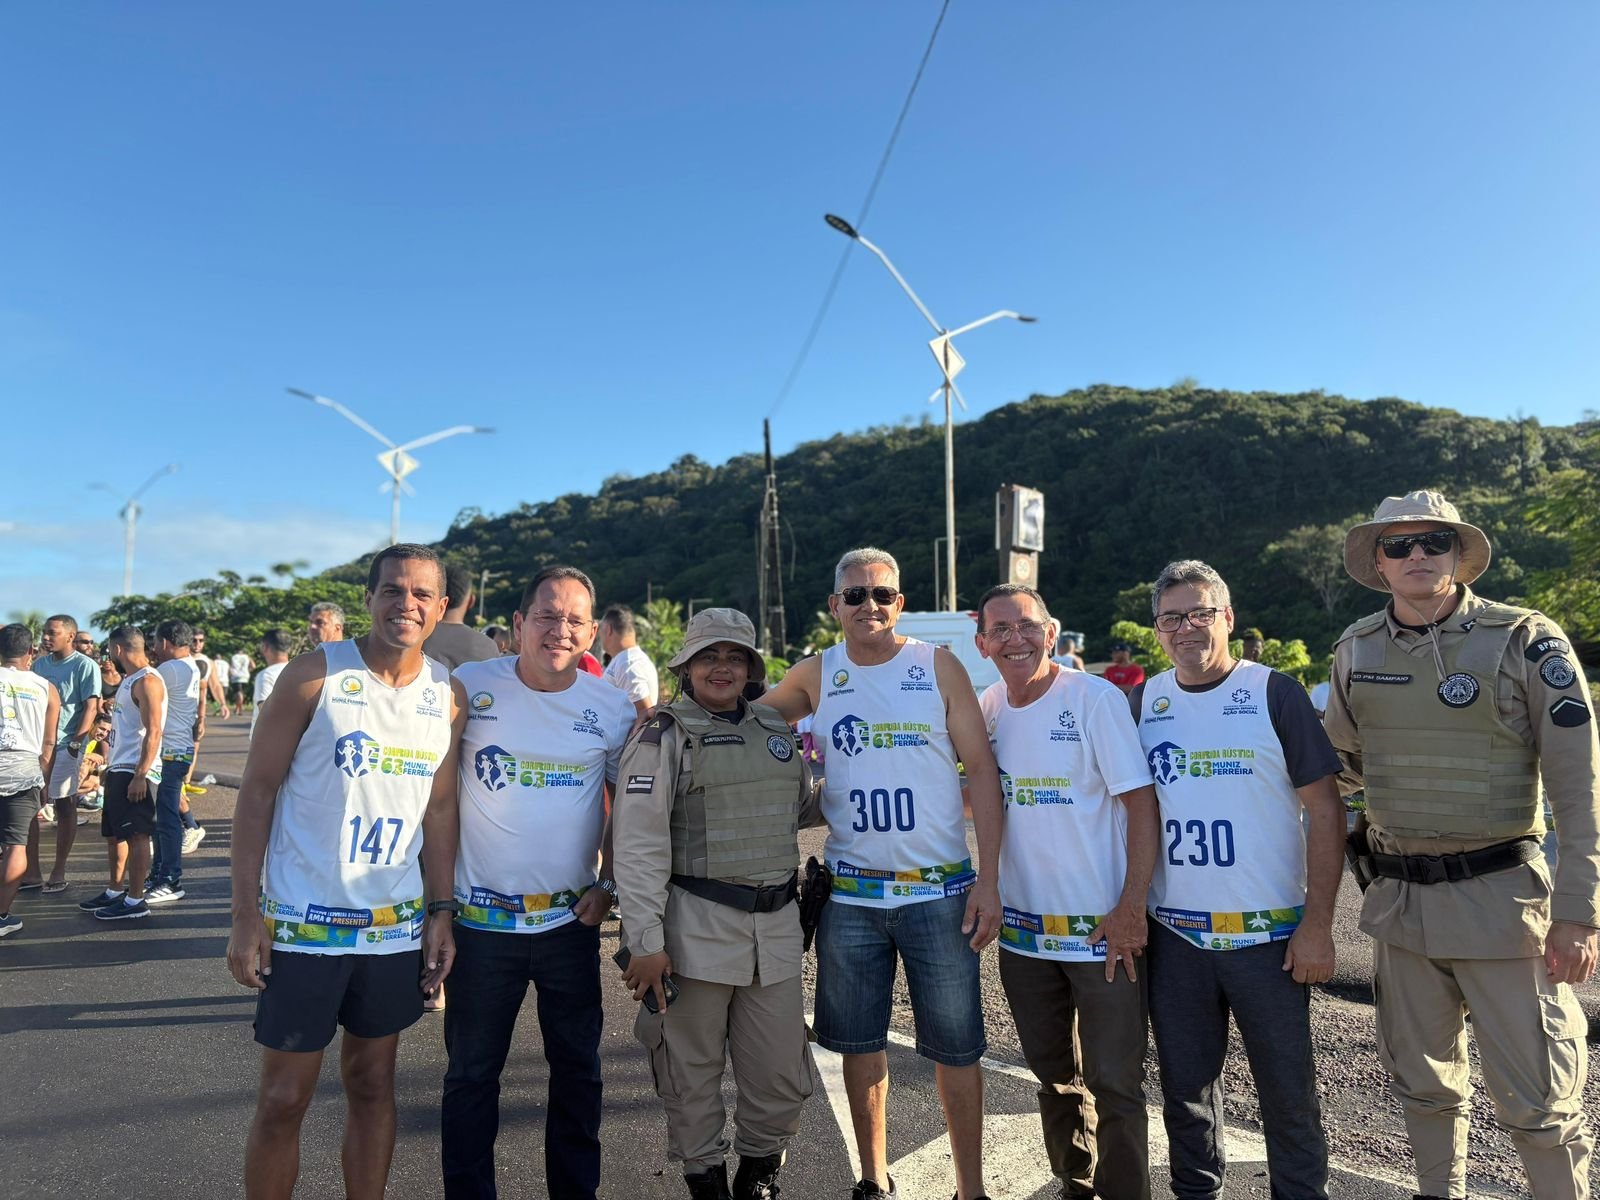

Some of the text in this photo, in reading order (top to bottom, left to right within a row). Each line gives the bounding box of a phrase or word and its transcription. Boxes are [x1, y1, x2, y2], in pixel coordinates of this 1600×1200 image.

[872, 732, 894, 749] 63
[381, 758, 403, 776] 63
[404, 760, 428, 770] MUNIZ
[1190, 760, 1212, 778] 63
[520, 770, 545, 788] 63
[1016, 788, 1034, 806] 63
[850, 788, 916, 832] 300
[350, 815, 404, 865] 147
[1166, 820, 1235, 867] 230
[892, 885, 910, 896] 63
[276, 909, 304, 917] FERREIRA
[308, 913, 324, 922] AMA
[332, 917, 368, 926] PRESENTE!
[1175, 920, 1207, 929] PRESENTE!
[1211, 938, 1232, 950] 63
